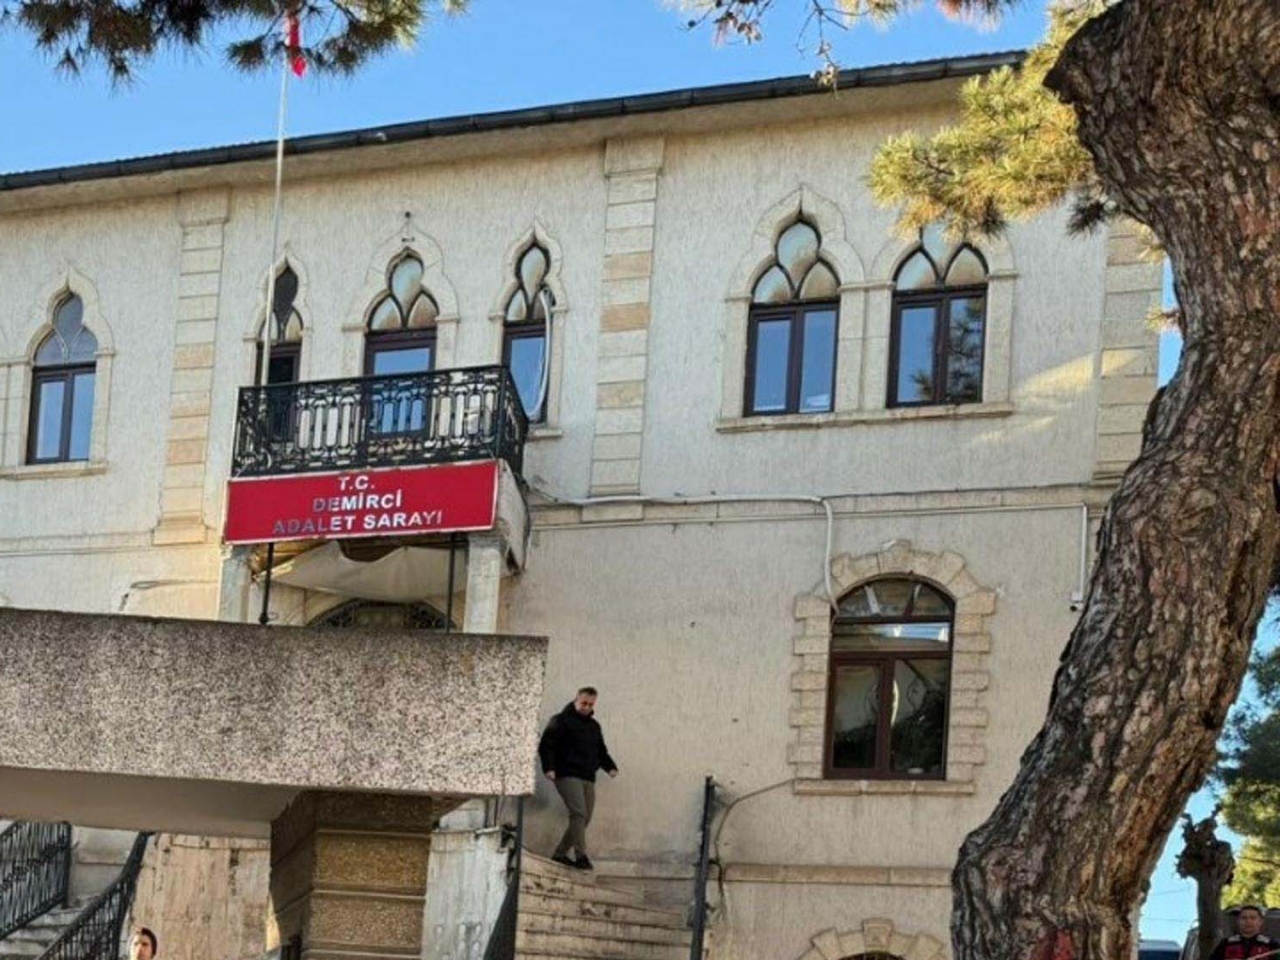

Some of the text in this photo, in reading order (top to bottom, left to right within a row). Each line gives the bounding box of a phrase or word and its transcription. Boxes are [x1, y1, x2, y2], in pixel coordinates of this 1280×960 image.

[339, 475, 375, 490] T.C.
[313, 489, 402, 512] DEMİRCİ
[273, 510, 443, 535] ADALET SARAYI
